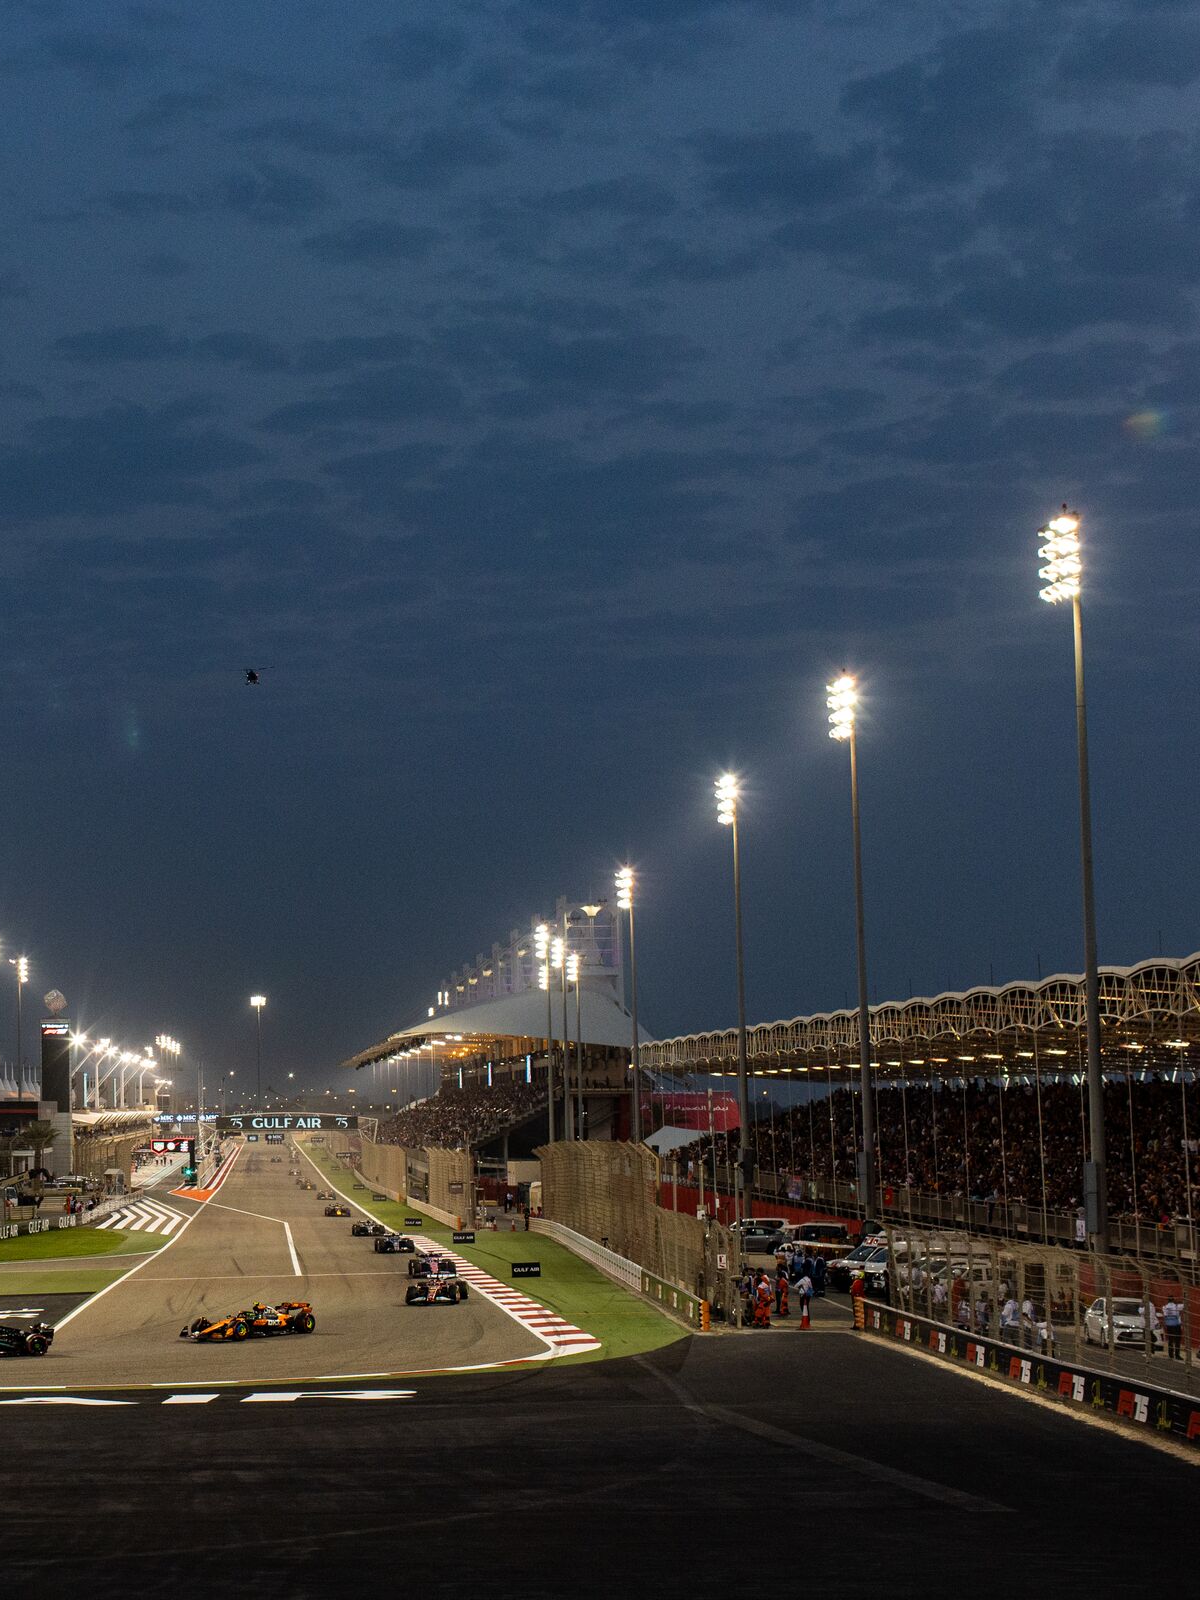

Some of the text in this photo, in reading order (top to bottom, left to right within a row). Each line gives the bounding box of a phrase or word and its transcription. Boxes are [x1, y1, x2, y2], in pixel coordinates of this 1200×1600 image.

[230, 1117, 348, 1129] 75 GULF AIR 75
[28, 1219, 50, 1234] GULF AIR
[58, 1216, 69, 1229] GULF
[10, 1224, 19, 1238] AIR
